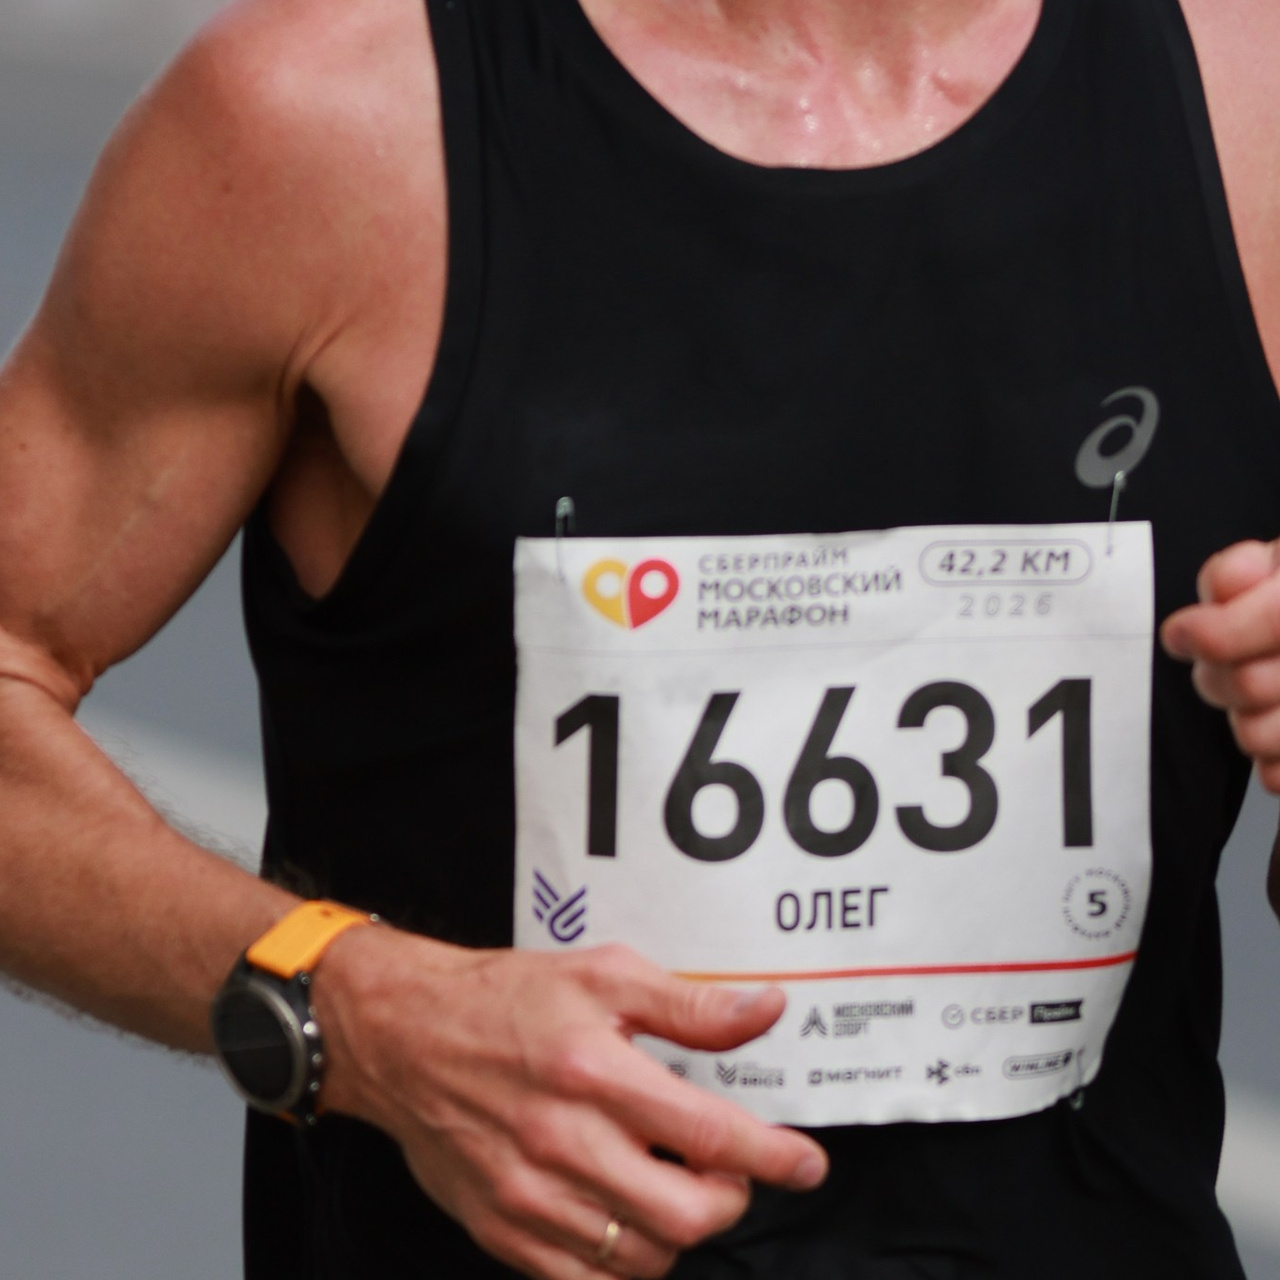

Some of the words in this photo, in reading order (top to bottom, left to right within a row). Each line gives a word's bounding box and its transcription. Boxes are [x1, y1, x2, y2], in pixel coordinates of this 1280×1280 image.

[698, 545, 847, 575] СБЕРПРАЙМ
[939, 549, 1008, 577] 42,2
[698, 565, 903, 602] МОСКОВСКИЙ
[698, 604, 849, 629] МАРАФОН
[958, 592, 1053, 618] 2026
[554, 677, 1093, 863] 16631
[775, 886, 889, 931] ОЛЕГ
[1088, 890, 1108, 917] 5
[971, 1006, 1024, 1024] СБЕР
